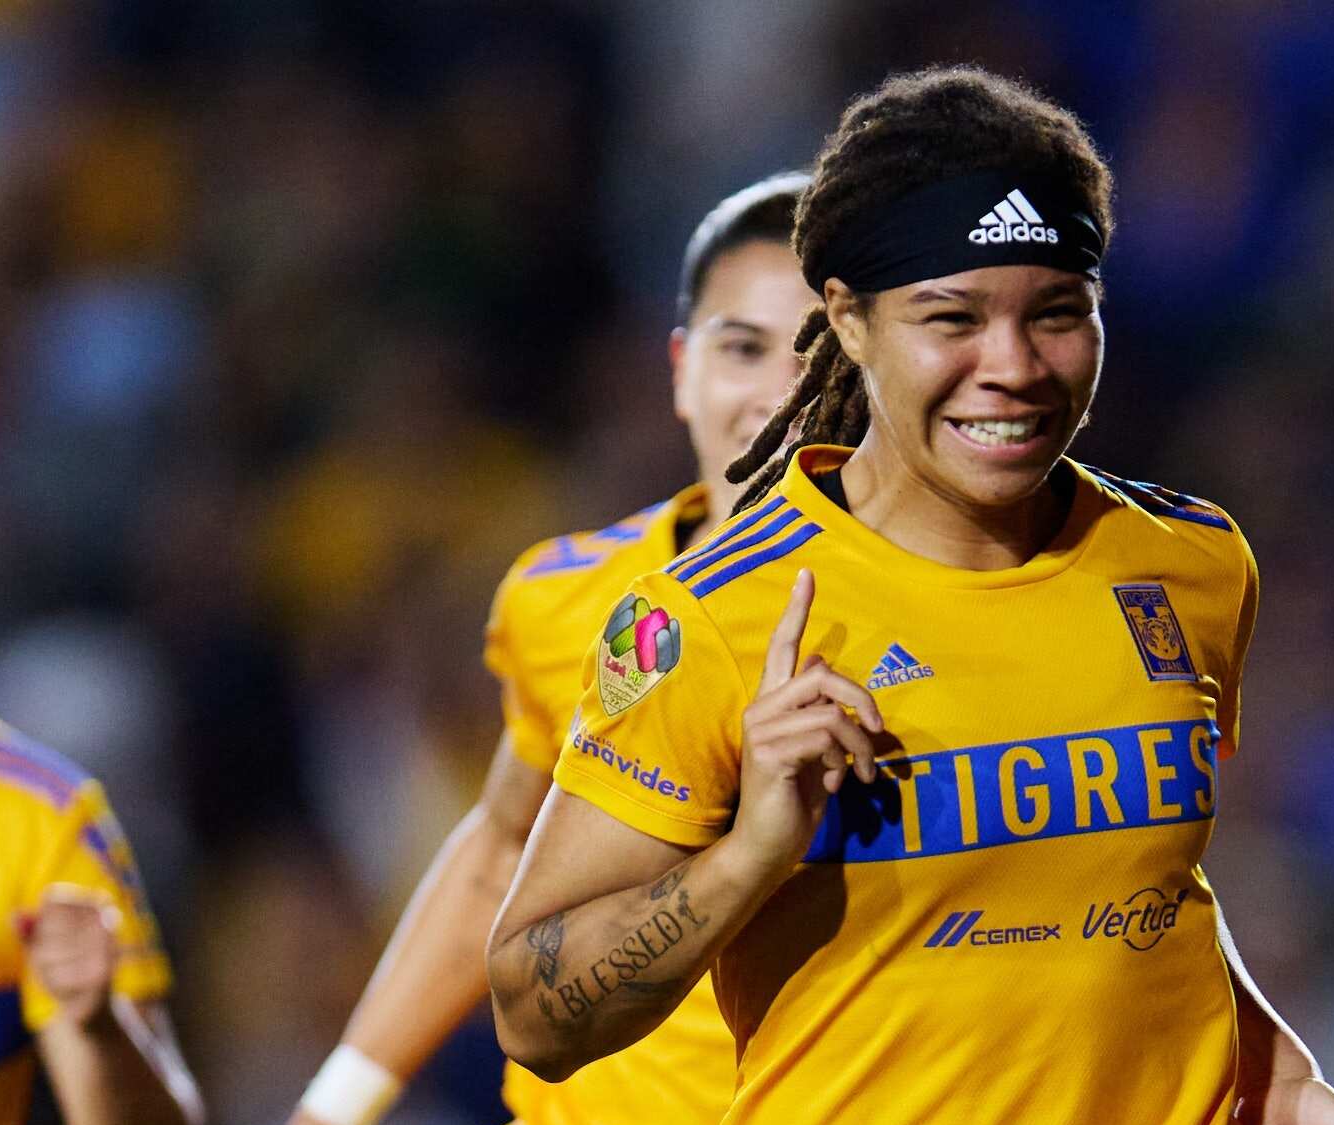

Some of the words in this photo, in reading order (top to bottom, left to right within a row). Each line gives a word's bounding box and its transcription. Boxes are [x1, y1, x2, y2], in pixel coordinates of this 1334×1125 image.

[968, 221, 1063, 244] adidas
[867, 665, 935, 690] adidas
[572, 730, 691, 802] enavides
[880, 724, 1216, 854] TIGRES
[970, 923, 1061, 946] CEMEX
[556, 910, 684, 1019] BLESSED
